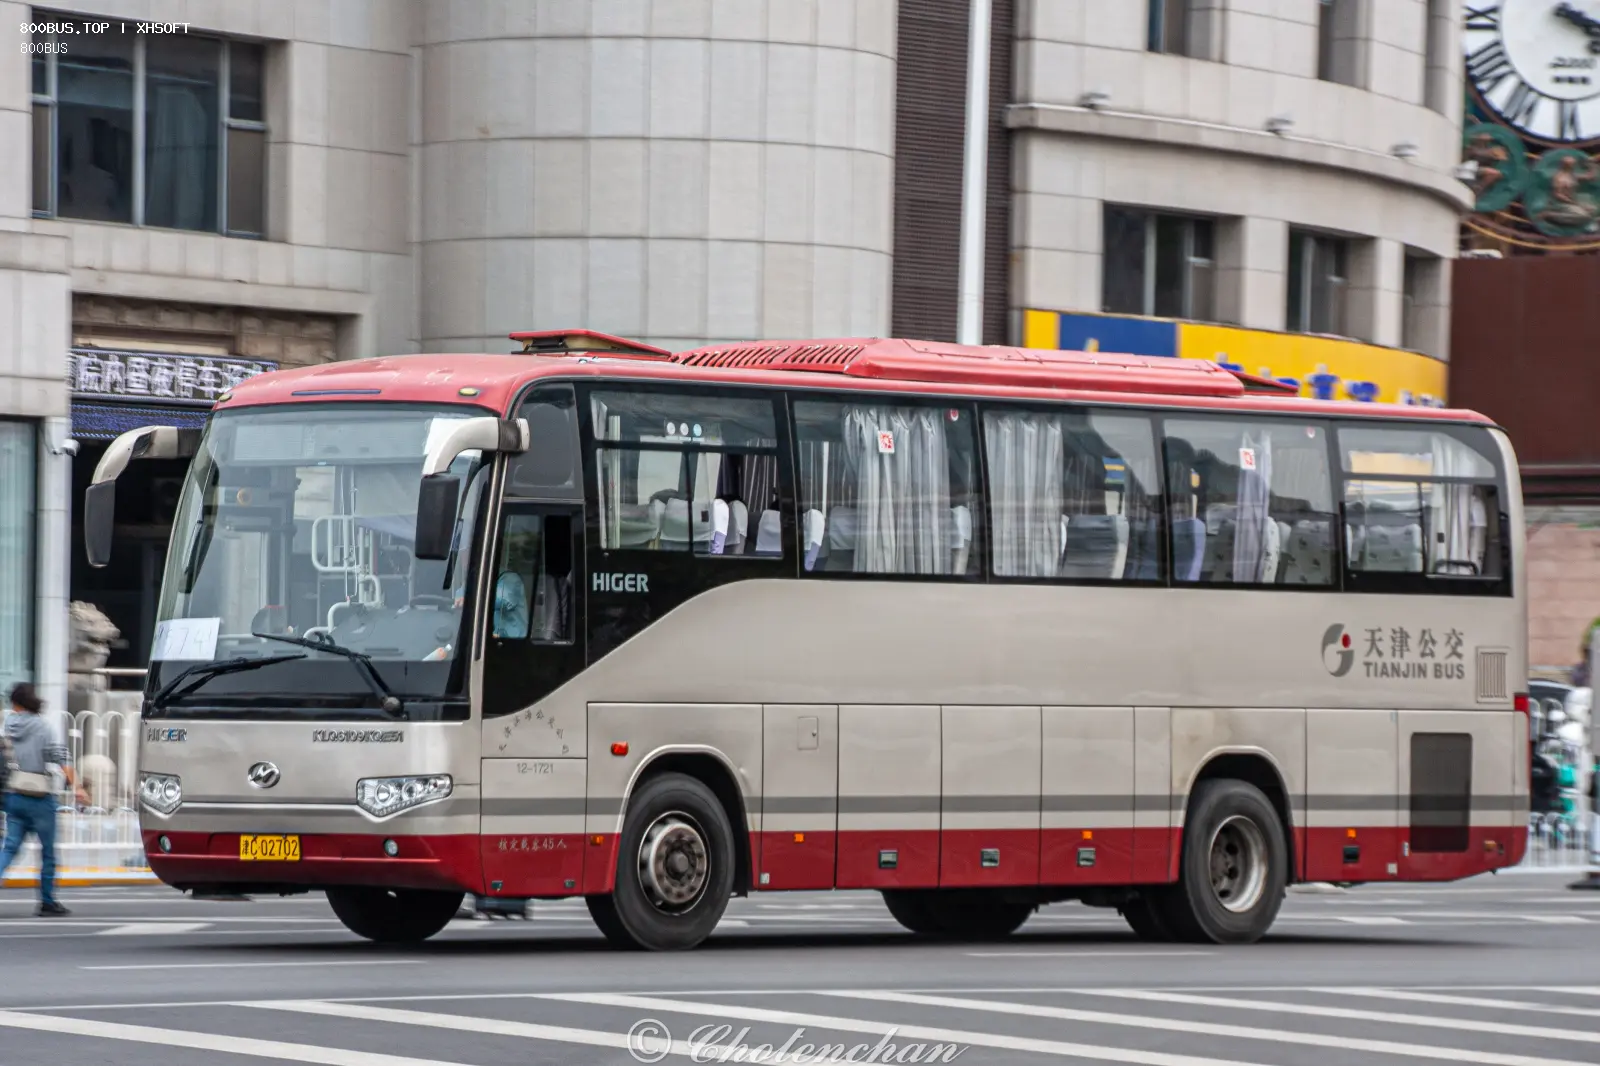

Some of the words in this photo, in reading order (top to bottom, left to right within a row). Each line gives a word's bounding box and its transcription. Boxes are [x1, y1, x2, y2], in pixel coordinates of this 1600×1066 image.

[592, 572, 649, 592] HIGER
[1363, 627, 1465, 659] 天津公交
[1363, 661, 1427, 678] TIANJIN
[1433, 662, 1465, 679] BUS
[516, 762, 554, 774] 12-1721
